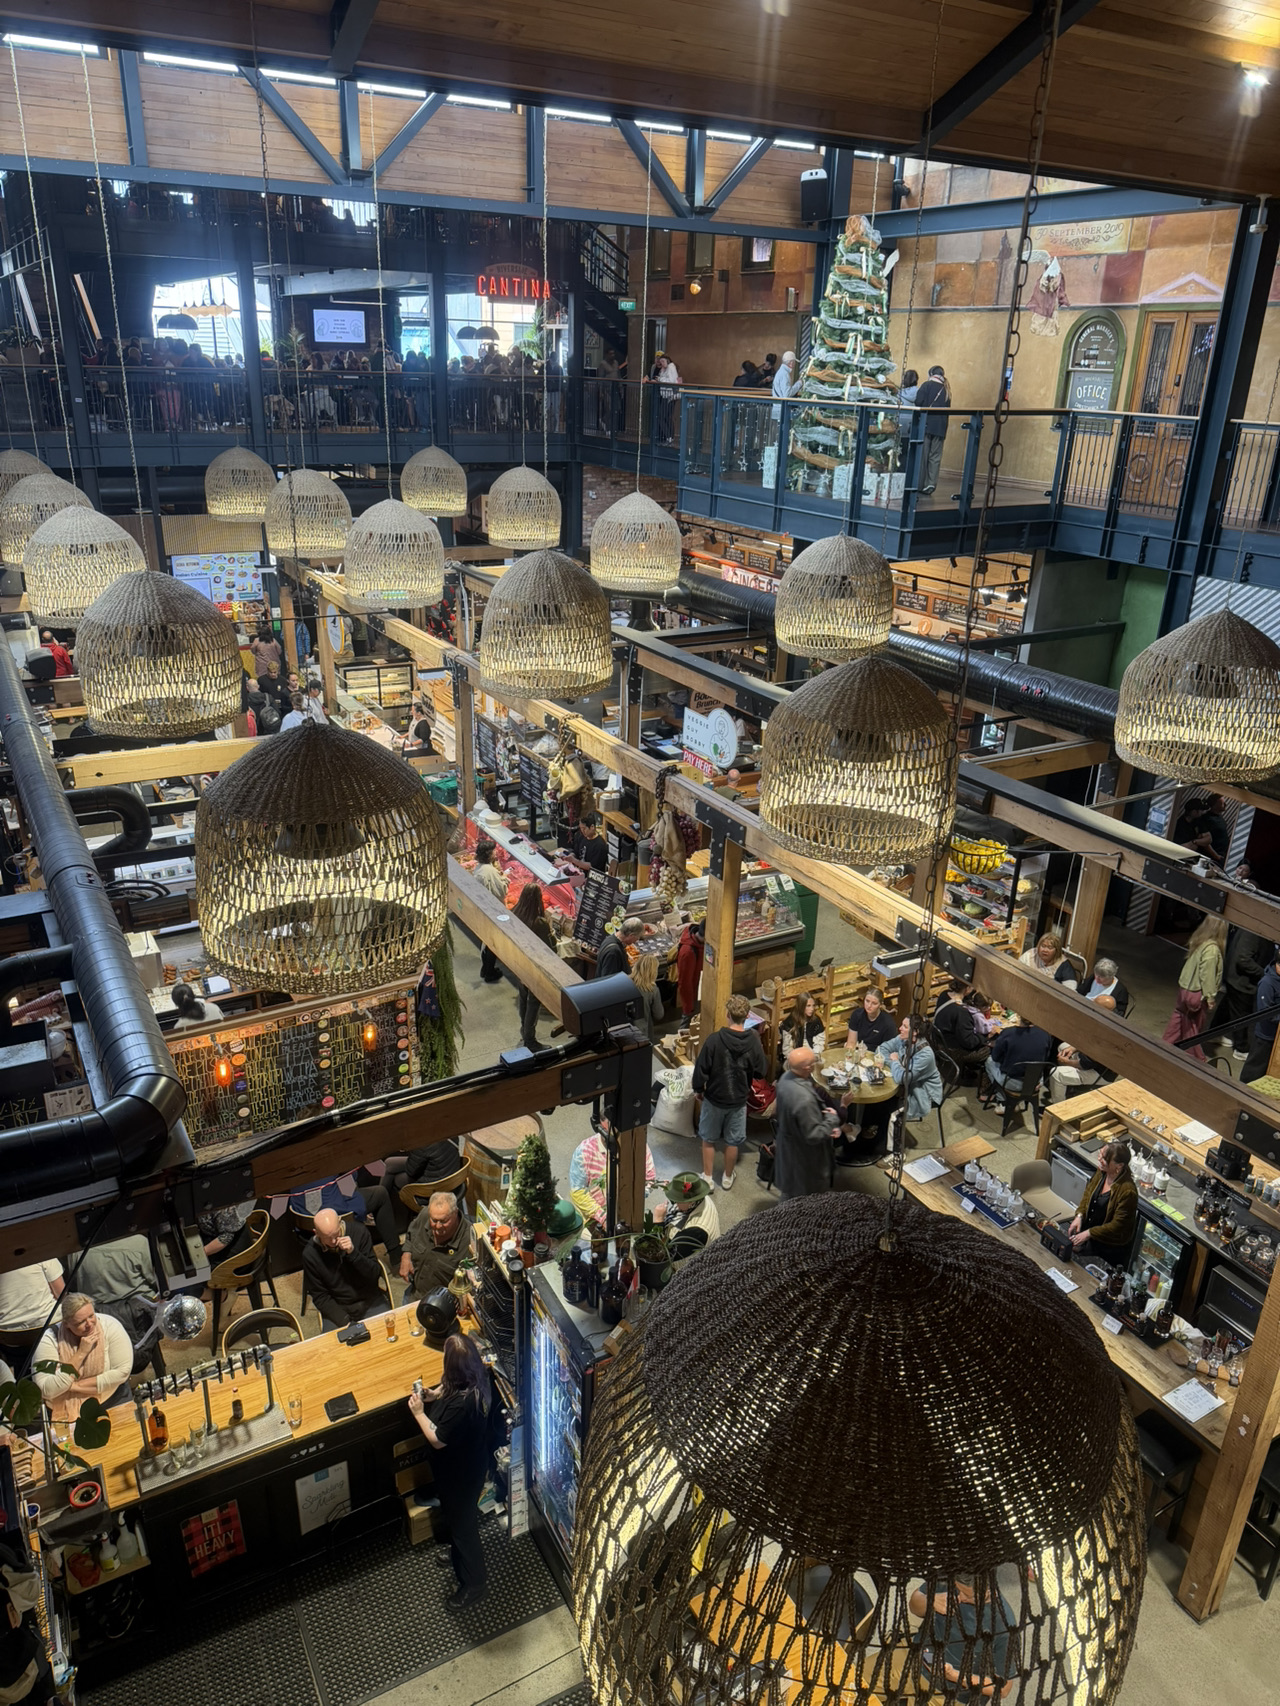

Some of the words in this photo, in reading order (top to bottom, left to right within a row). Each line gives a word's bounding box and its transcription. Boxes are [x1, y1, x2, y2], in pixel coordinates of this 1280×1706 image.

[1049, 226, 1102, 238] SEPTEMBER
[1103, 222, 1125, 235] 2019
[478, 275, 550, 298] CANTINA
[687, 724, 699, 735] GUY
[688, 714, 710, 730] VEGGIE
[686, 735, 706, 748] BOBBY
[683, 750, 695, 768] PAY
[695, 757, 713, 775] HERE
[286, 1047, 314, 1066] IPA
[218, 1110, 237, 1126] IPA
[203, 1521, 222, 1540] ITI
[194, 1529, 235, 1560] HEAVY
